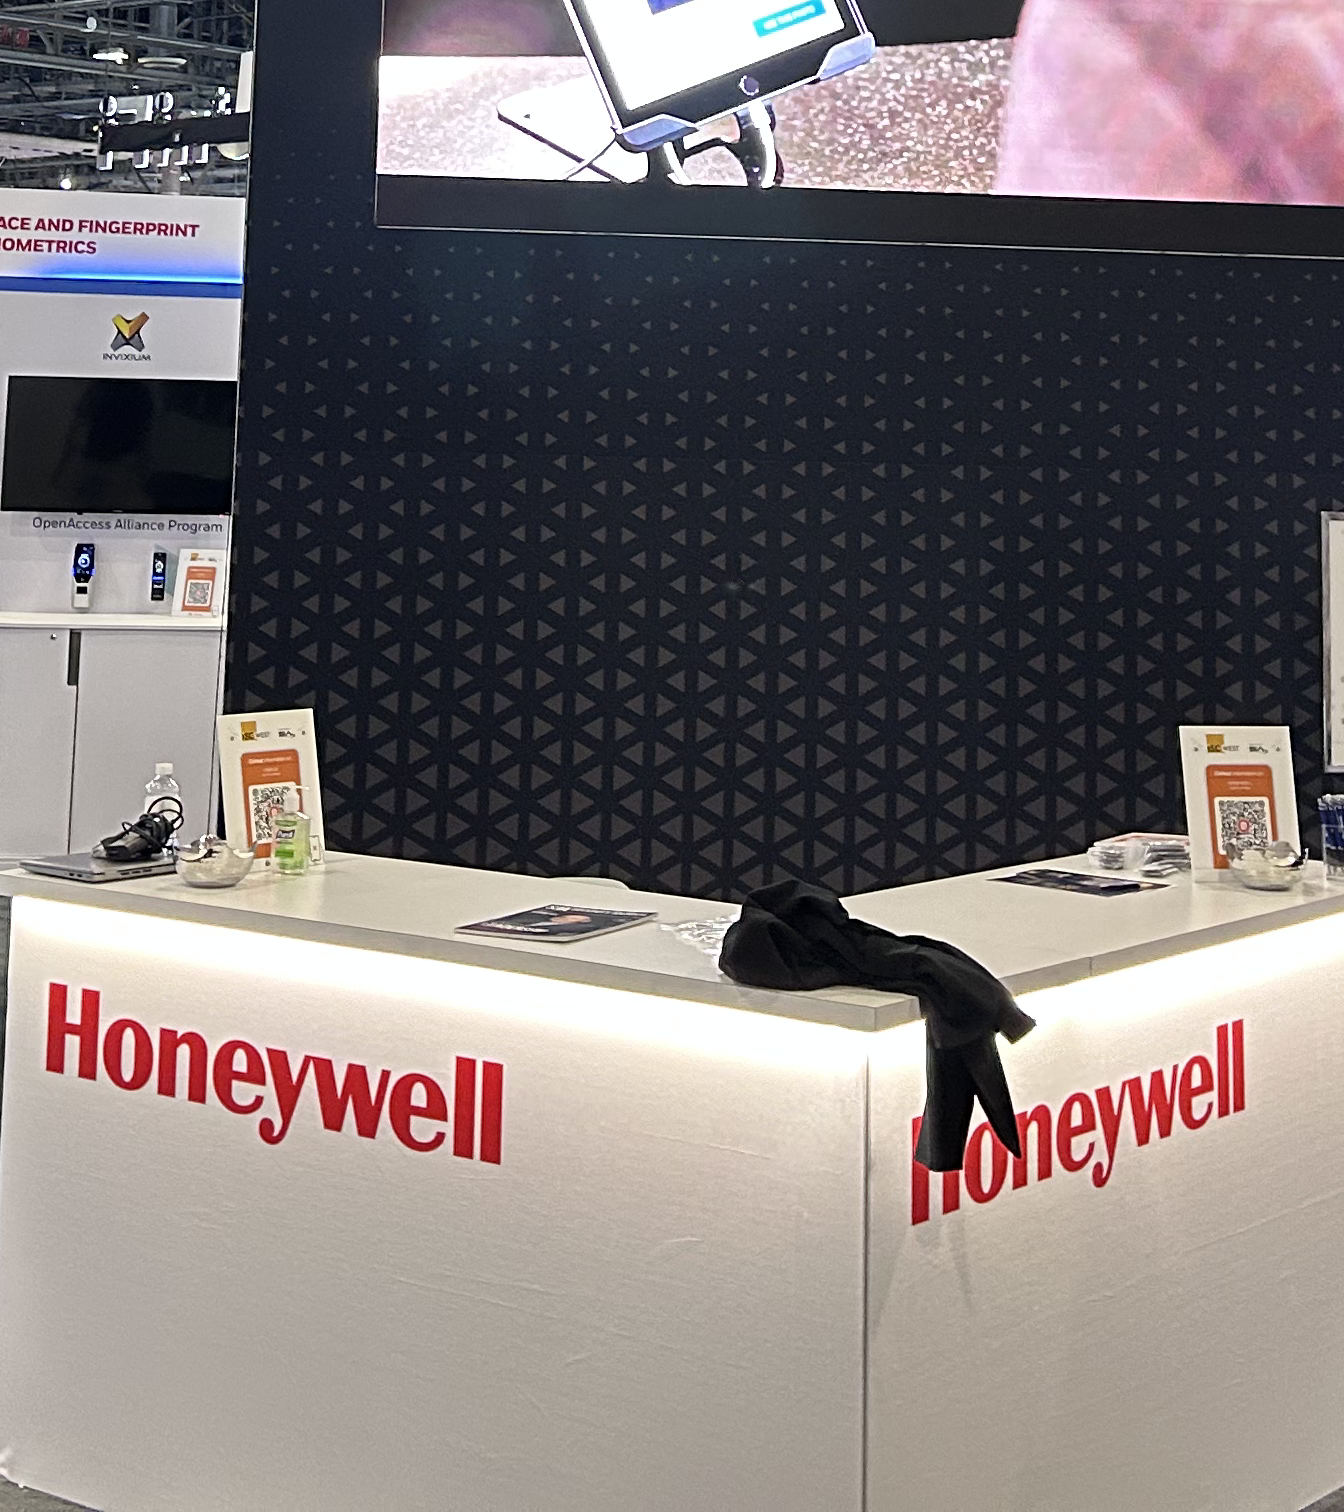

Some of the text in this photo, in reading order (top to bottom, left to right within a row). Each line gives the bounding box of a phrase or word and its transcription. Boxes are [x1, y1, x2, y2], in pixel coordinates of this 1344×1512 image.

[34, 217, 74, 232] AND
[77, 219, 200, 238] FINGERPRINT
[102, 352, 151, 362] INVIXIUM
[32, 516, 223, 535] OpenAccess Alliance Program
[44, 980, 506, 1166] Honeywell
